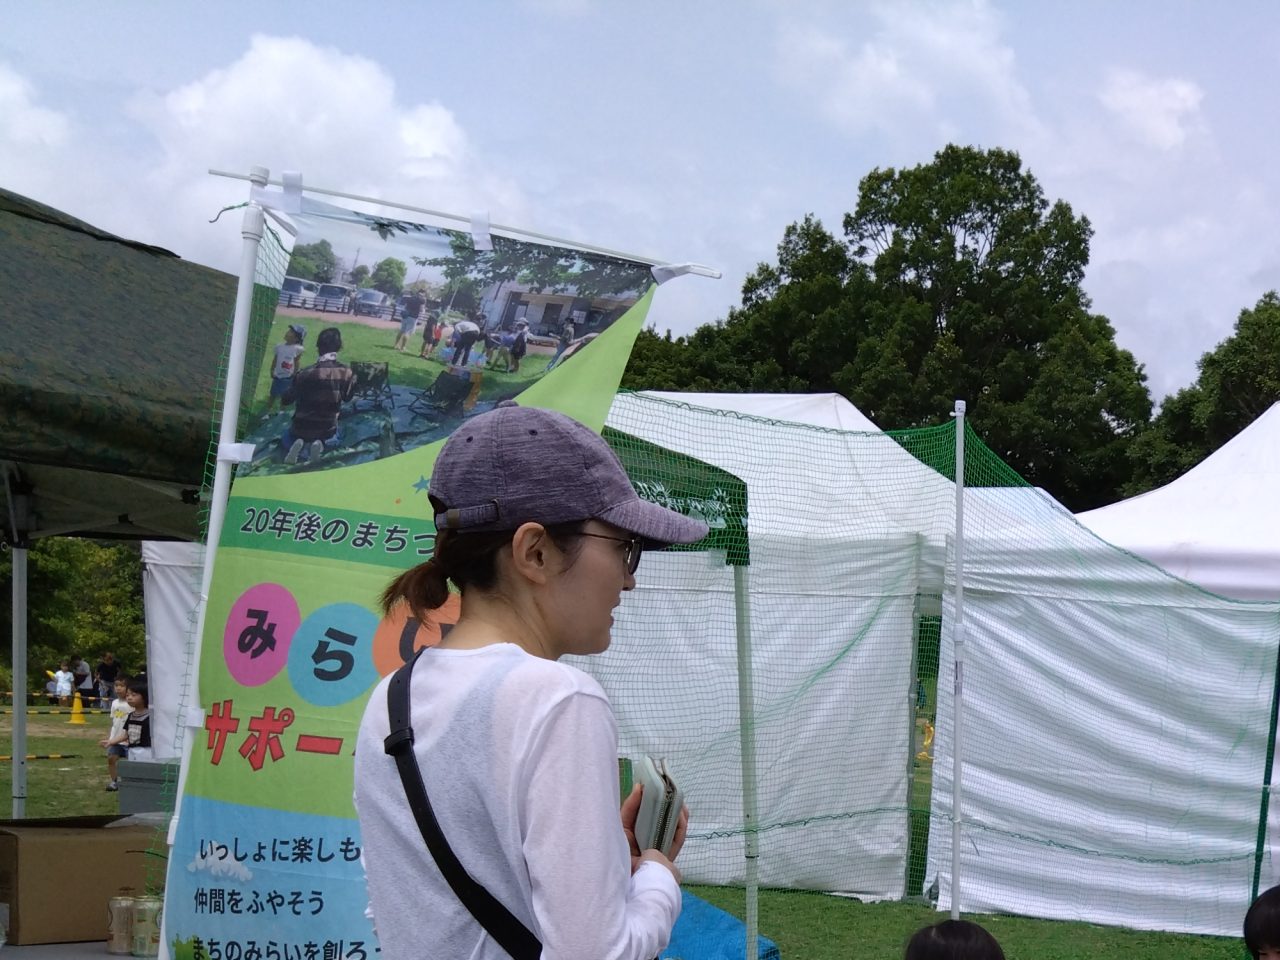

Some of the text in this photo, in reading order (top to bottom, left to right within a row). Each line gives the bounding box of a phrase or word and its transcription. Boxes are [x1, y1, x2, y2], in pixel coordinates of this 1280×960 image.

[205, 699, 356, 771] サポー
[200, 837, 361, 863] いっしょに楽しも
[194, 887, 325, 915] 仲間をふやそう
